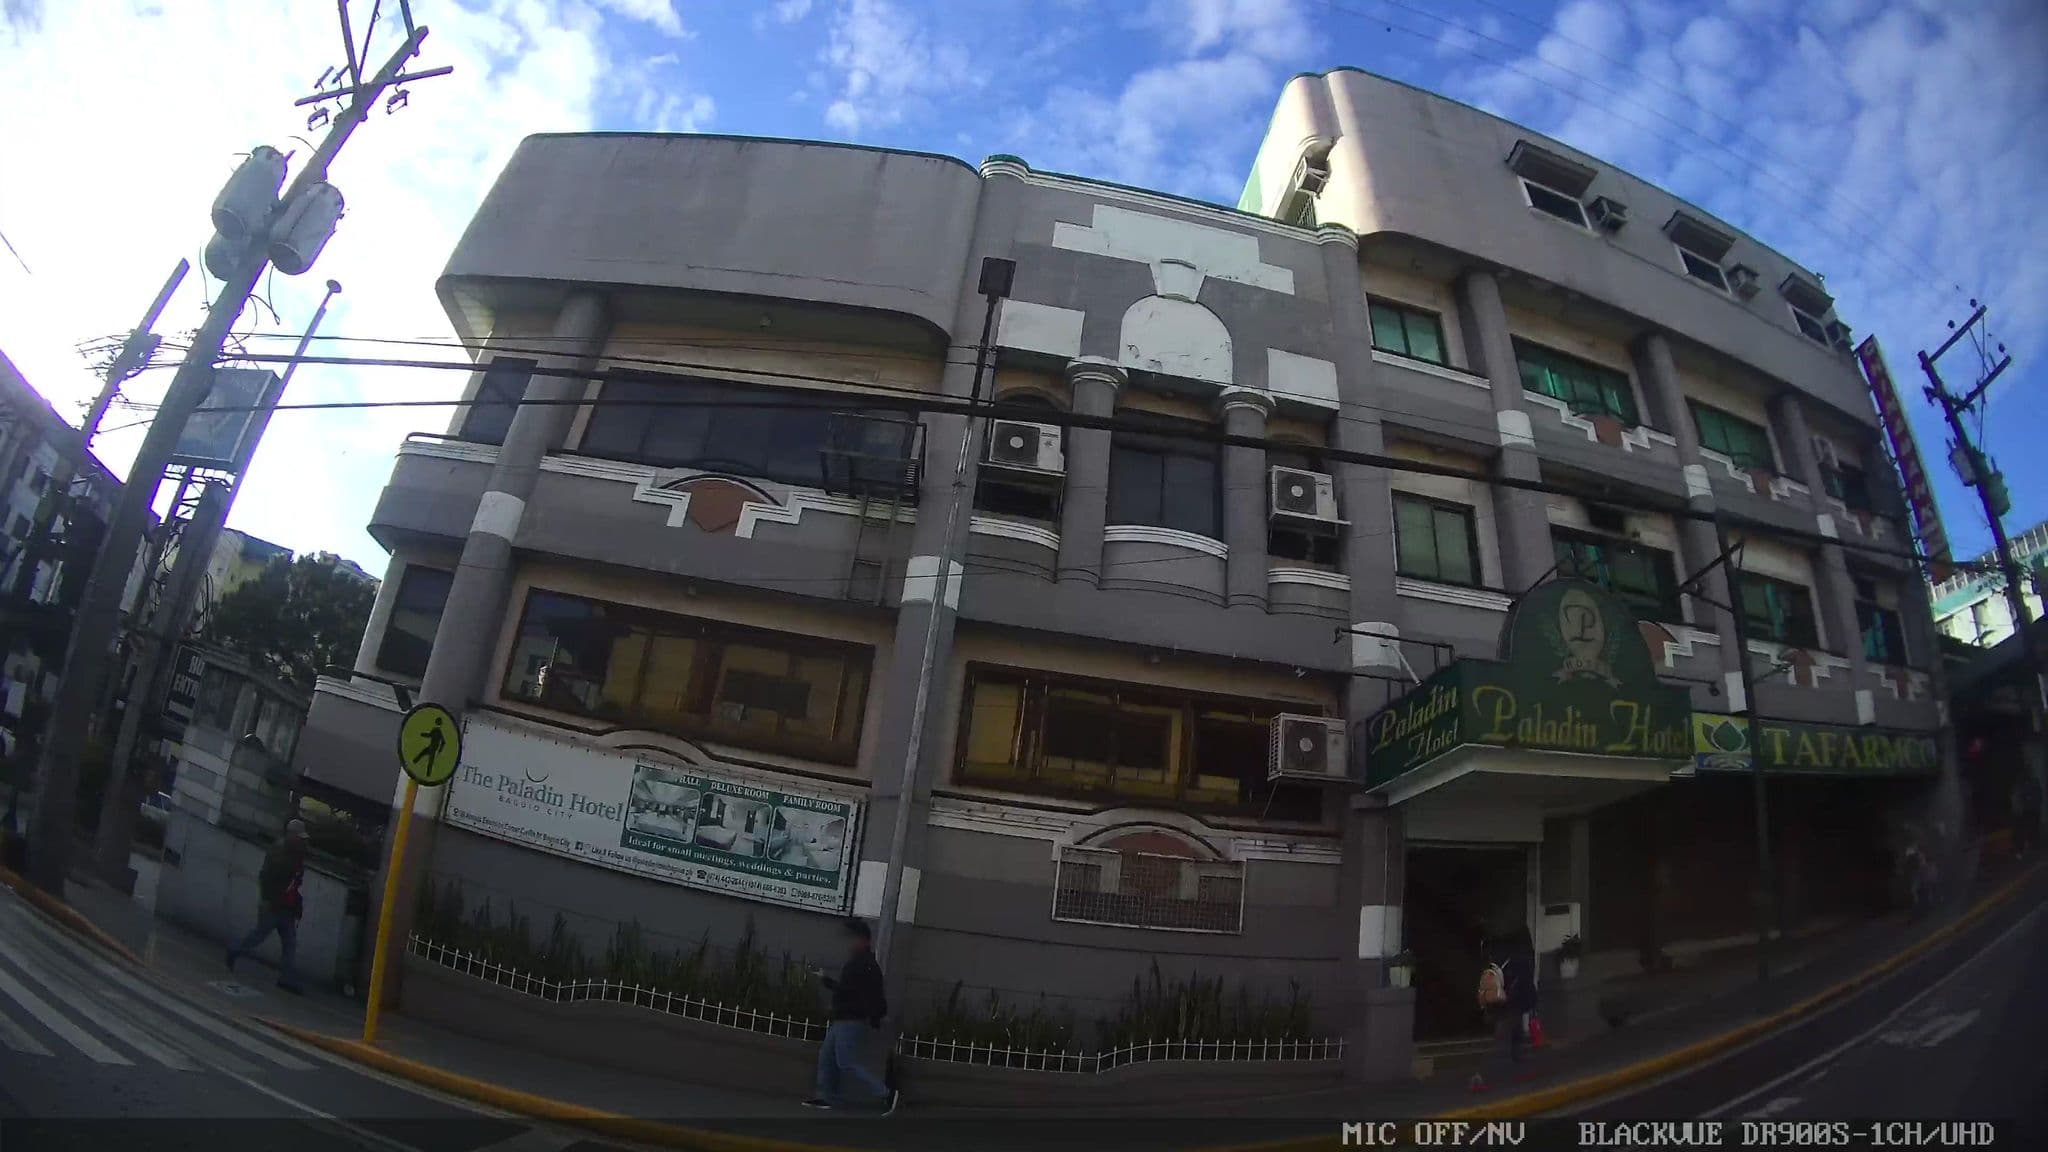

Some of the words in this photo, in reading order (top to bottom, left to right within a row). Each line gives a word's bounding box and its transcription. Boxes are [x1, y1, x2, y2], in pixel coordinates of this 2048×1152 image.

[172, 672, 200, 700] ENTR
[1369, 684, 1458, 755] Paladin
[1471, 684, 1599, 749] Paladin
[1604, 699, 1690, 755] Hotel
[1403, 716, 1459, 768] Hotel
[463, 764, 493, 789] The
[497, 774, 564, 808] Paladin
[568, 792, 623, 822] Hotel
[710, 781, 744, 796] DELUXE
[744, 787, 770, 800] ROOM
[783, 795, 814, 808] FAMILY
[815, 802, 842, 812] ROOM
[546, 807, 573, 820] CITY
[628, 835, 652, 849] Ideal
[651, 841, 668, 851] for
[668, 845, 692, 858] small
[739, 858, 783, 876] weddings
[783, 869, 794, 878] &
